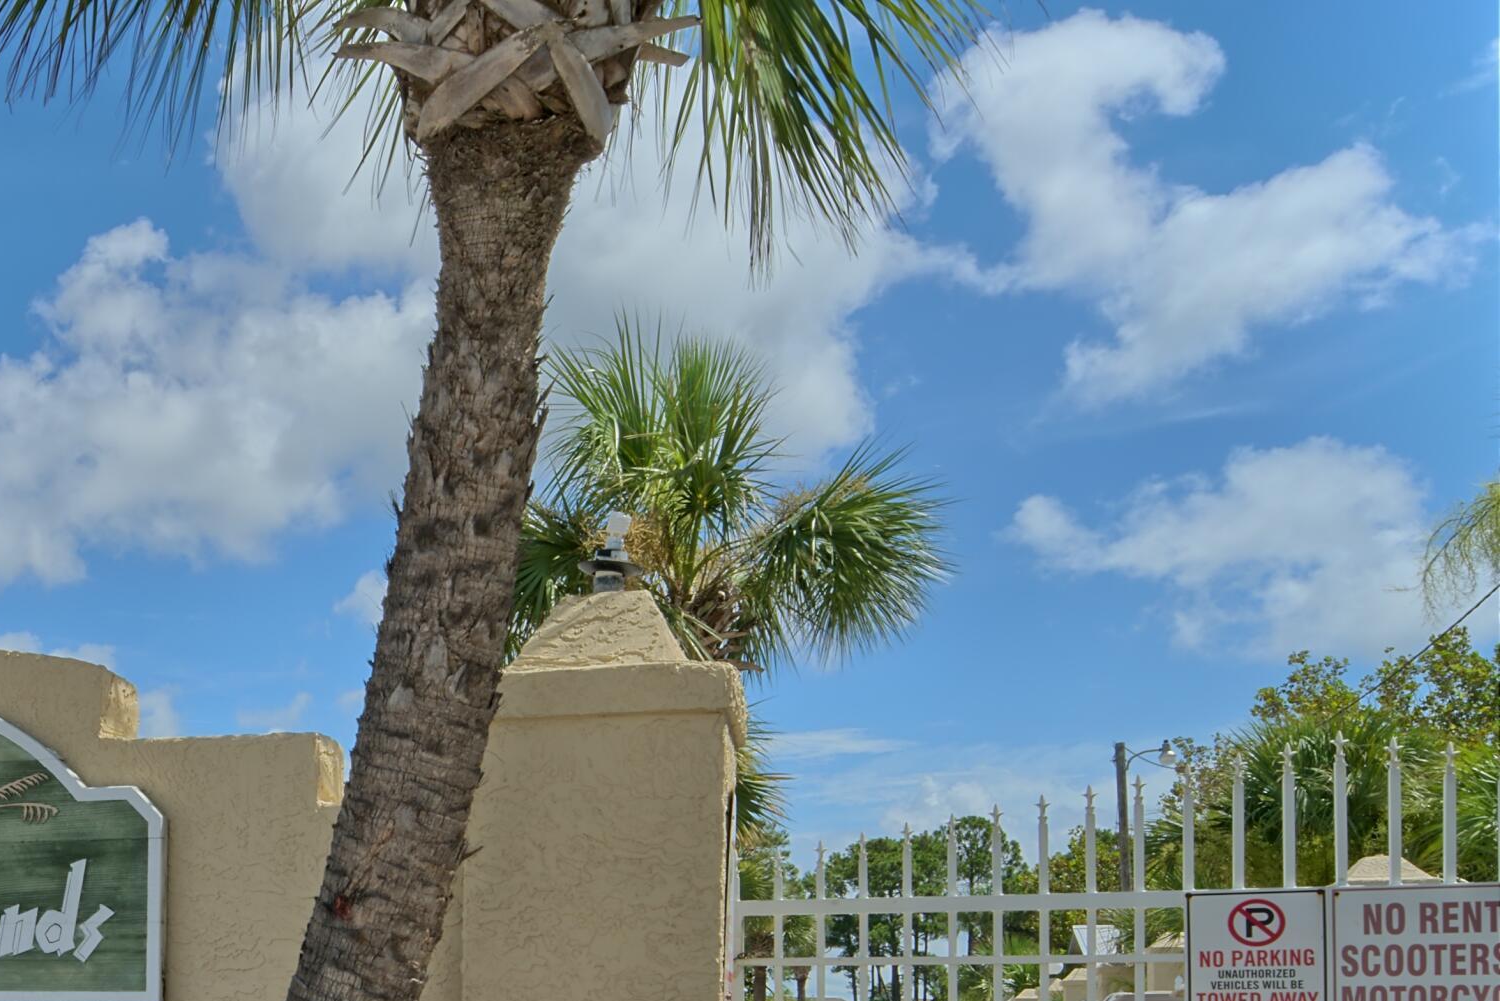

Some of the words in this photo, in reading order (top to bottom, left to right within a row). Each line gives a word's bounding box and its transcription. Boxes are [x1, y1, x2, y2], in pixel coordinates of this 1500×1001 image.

[1363, 902, 1406, 935] NO
[1199, 950, 1224, 967] NO
[1231, 949, 1315, 967] PARKING
[1218, 969, 1296, 979] UNAUTHORIZED
[1211, 980, 1259, 990] VEHICLES
[1262, 980, 1287, 990] WILL
[1290, 980, 1304, 989] BE
